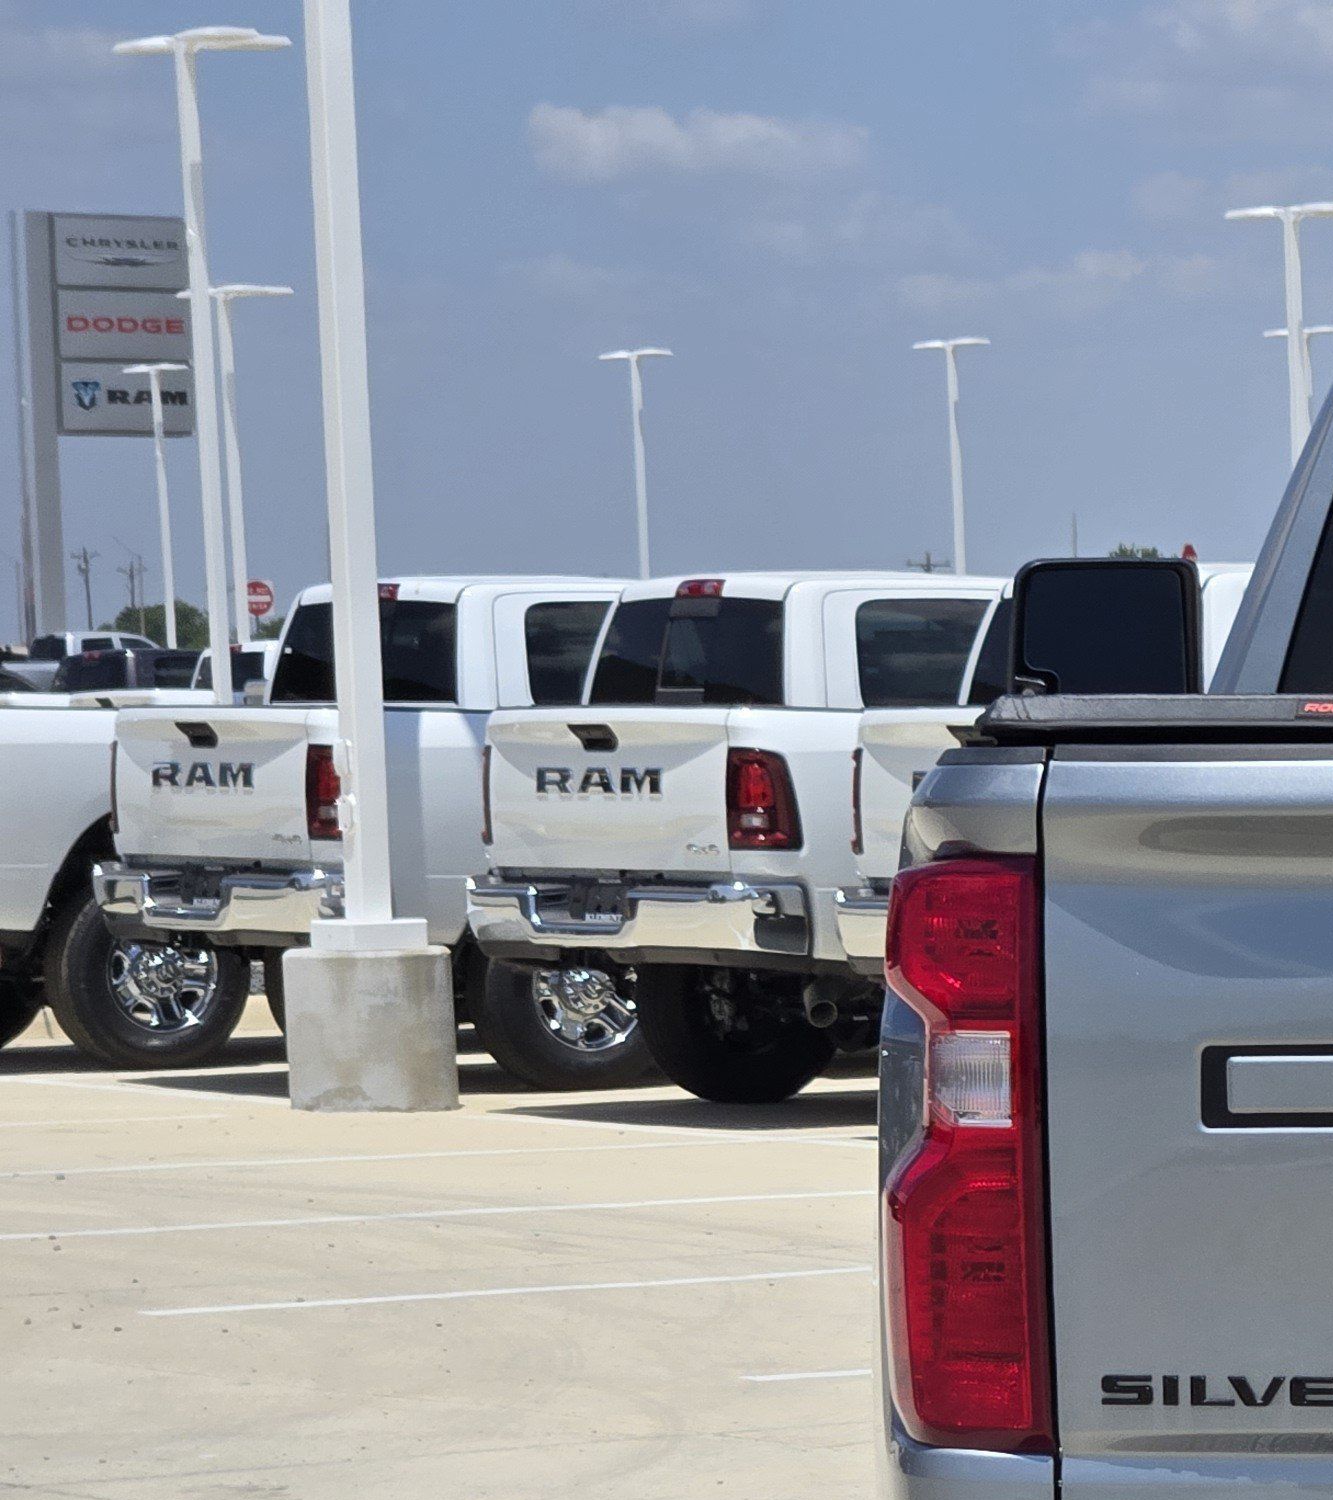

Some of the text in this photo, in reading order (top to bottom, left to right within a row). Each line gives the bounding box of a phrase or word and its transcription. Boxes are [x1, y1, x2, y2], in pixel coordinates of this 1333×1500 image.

[65, 236, 180, 251] CHRYSLER
[66, 316, 185, 335] DODGE
[151, 761, 255, 788] RAM
[536, 767, 663, 794] RAM
